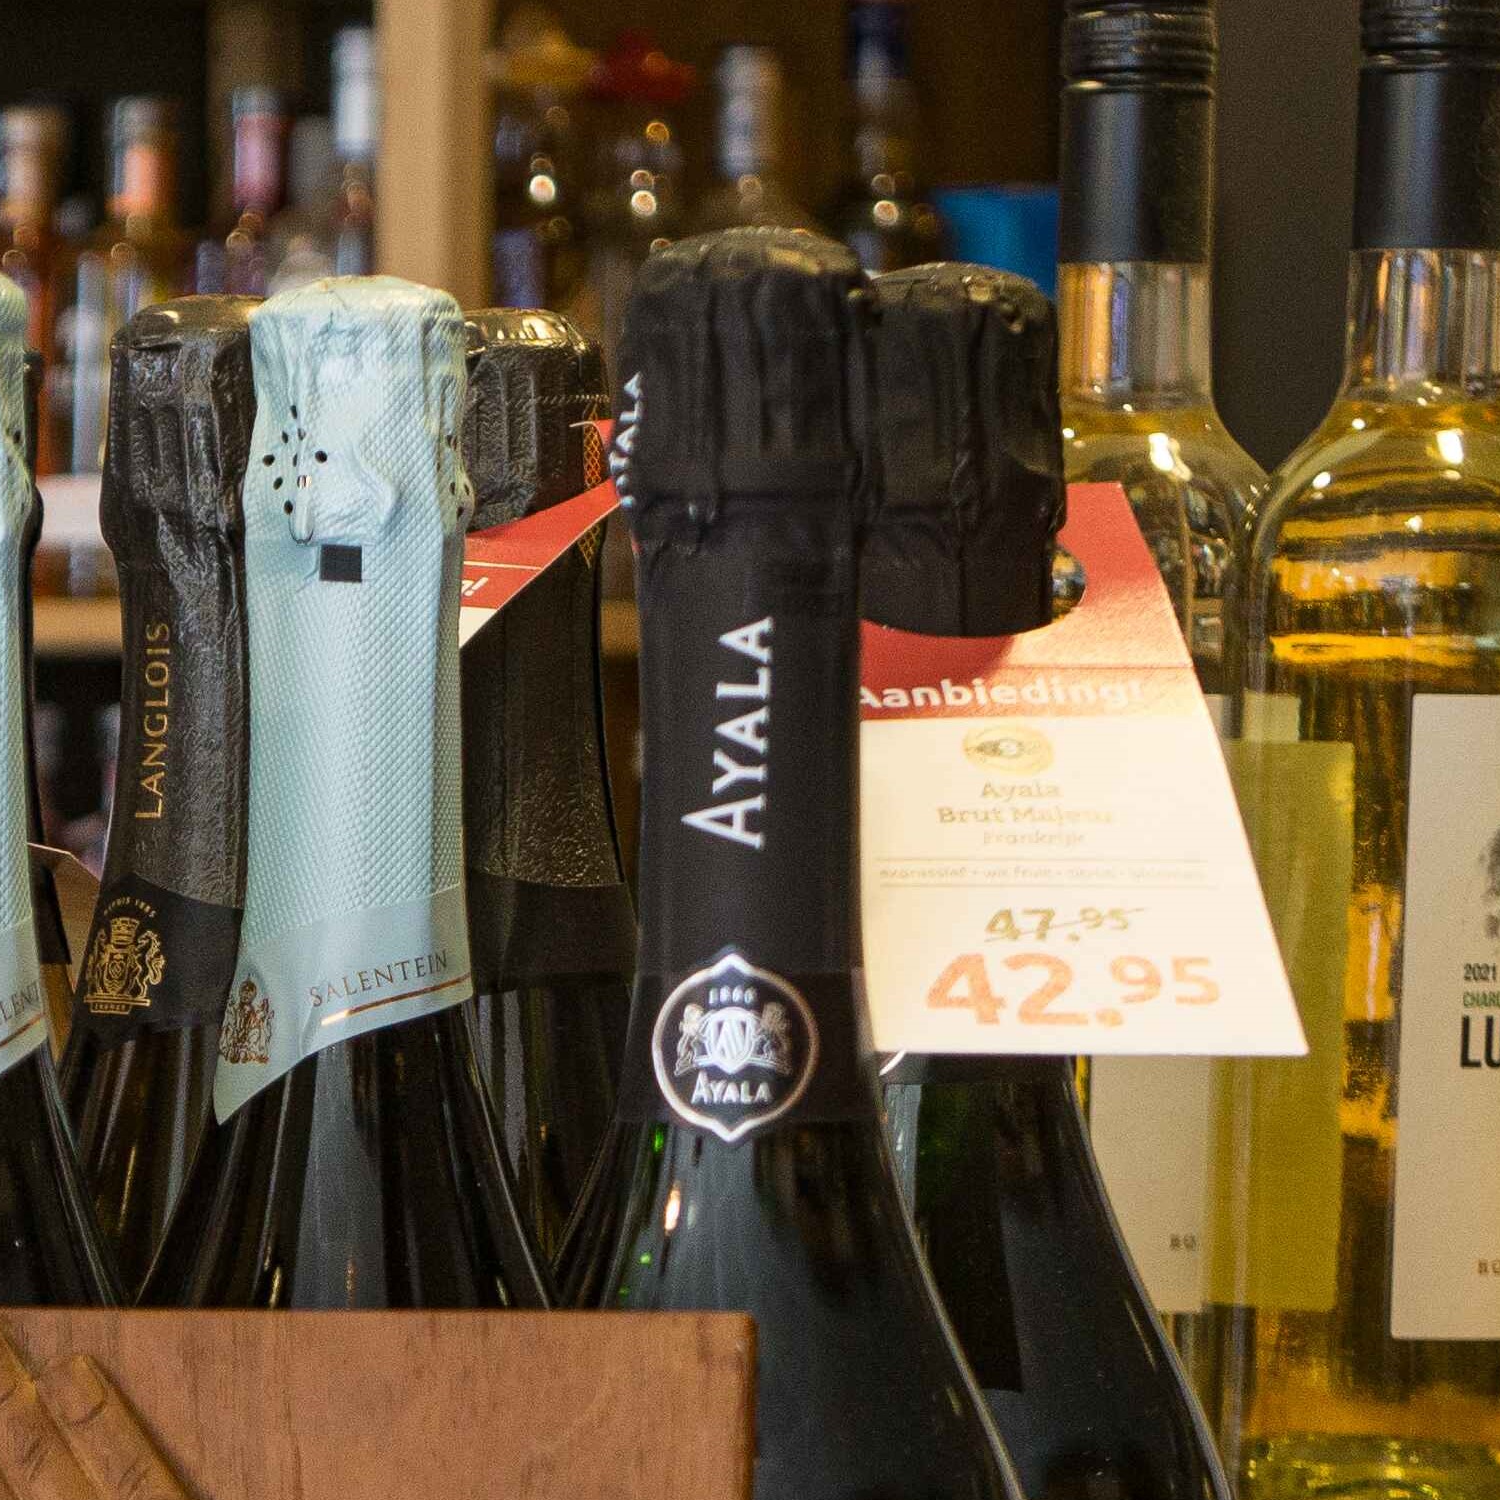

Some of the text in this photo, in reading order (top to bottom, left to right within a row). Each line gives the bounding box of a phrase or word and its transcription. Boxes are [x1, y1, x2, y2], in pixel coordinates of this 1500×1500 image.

[858, 676, 1147, 710] Aanbieding!
[134, 623, 171, 820] LANGLOIS
[680, 616, 774, 850] AYALA
[984, 906, 1132, 942] 47.95
[309, 950, 450, 1009] SALENTEIN
[924, 952, 1222, 1027] 42.95
[1463, 962, 1498, 982] 2021
[690, 1070, 774, 1105] AYALA
